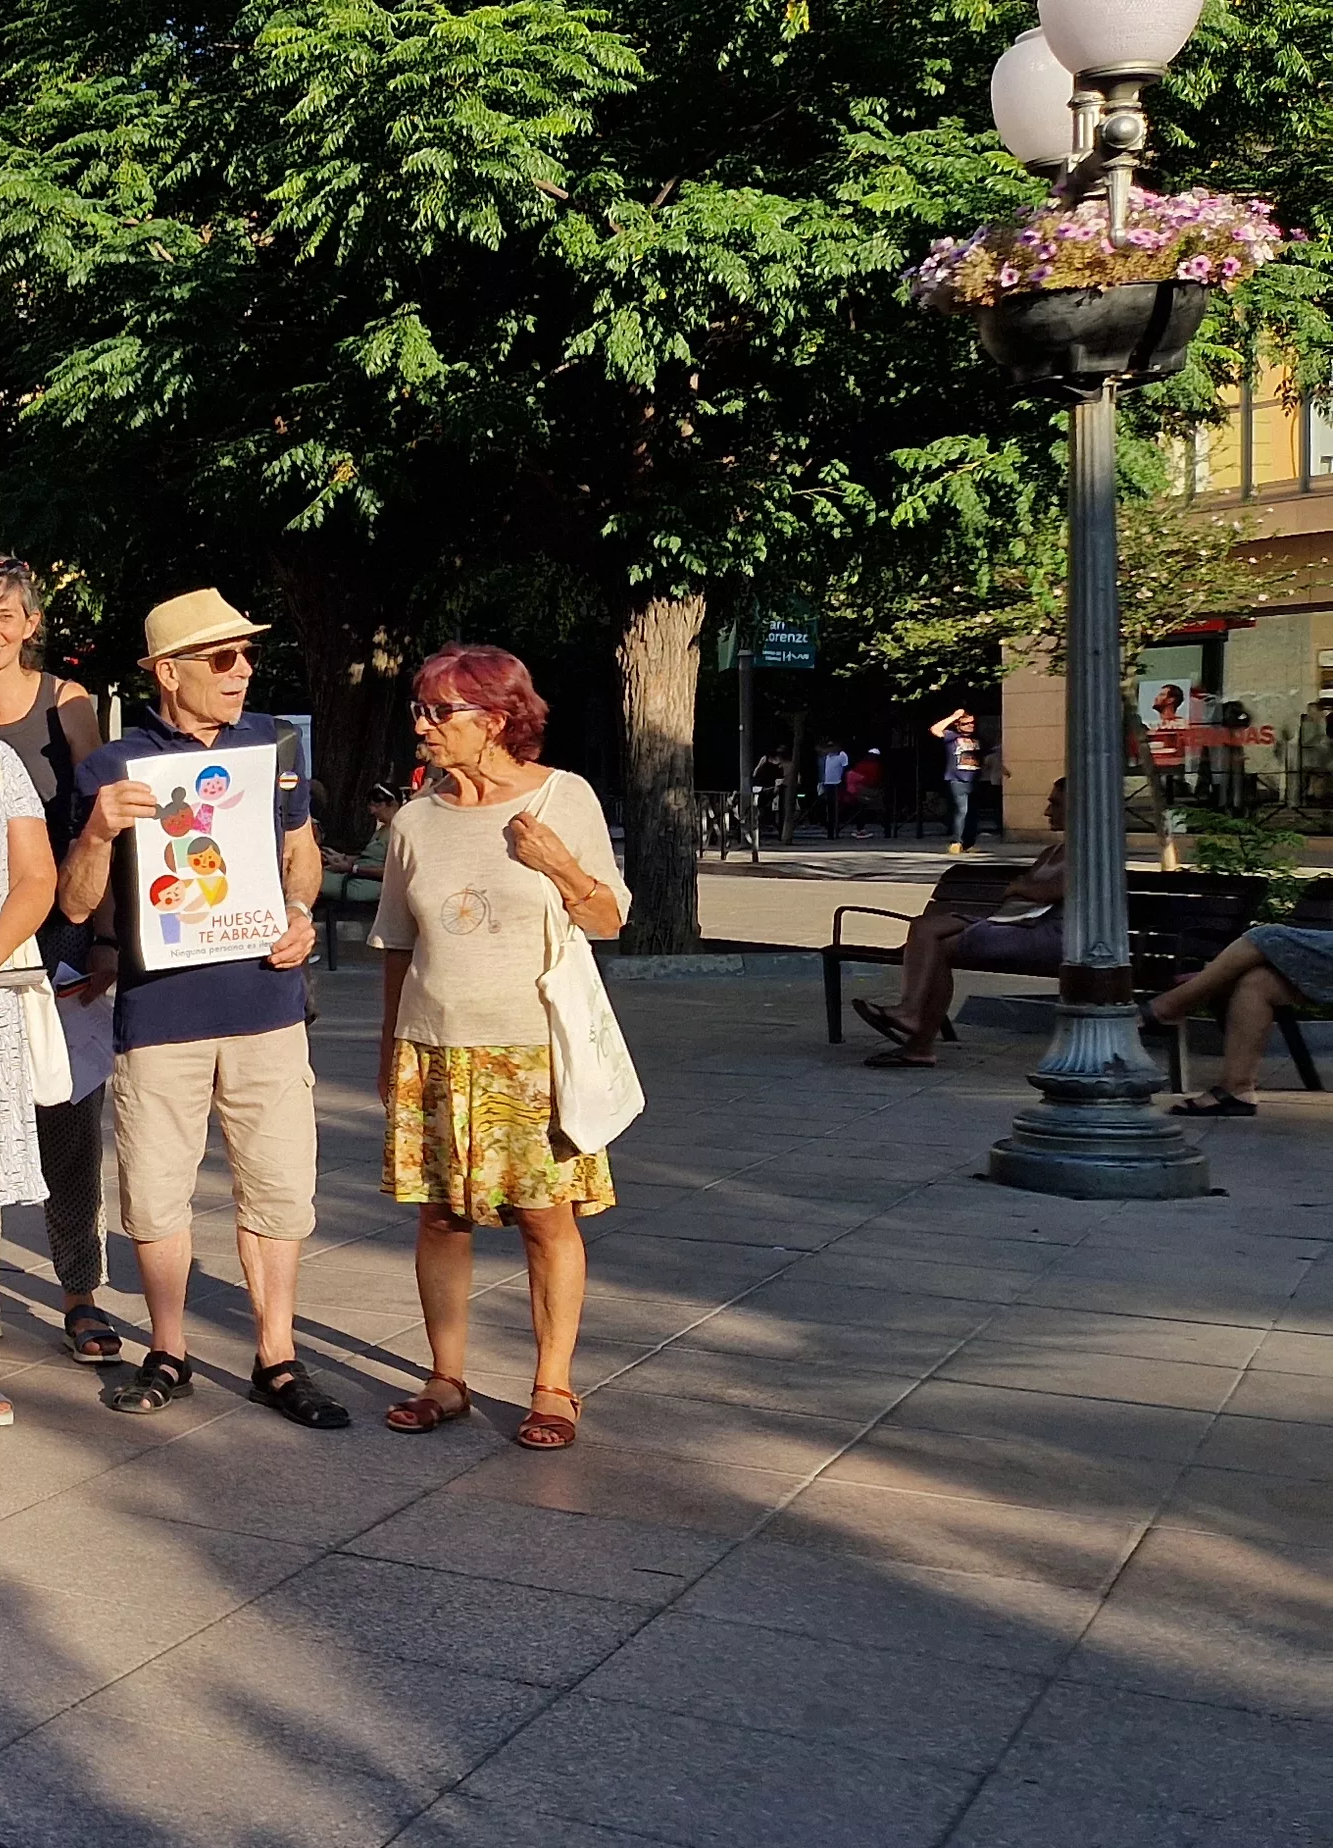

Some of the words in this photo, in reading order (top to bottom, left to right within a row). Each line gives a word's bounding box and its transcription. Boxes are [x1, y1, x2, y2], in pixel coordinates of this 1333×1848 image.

[764, 632, 809, 643] orenzo
[212, 909, 275, 928] HUESCA
[199, 930, 214, 944] TE
[220, 924, 282, 942] ABRAZA
[170, 948, 207, 959] Ninguna
[209, 944, 245, 956] persona
